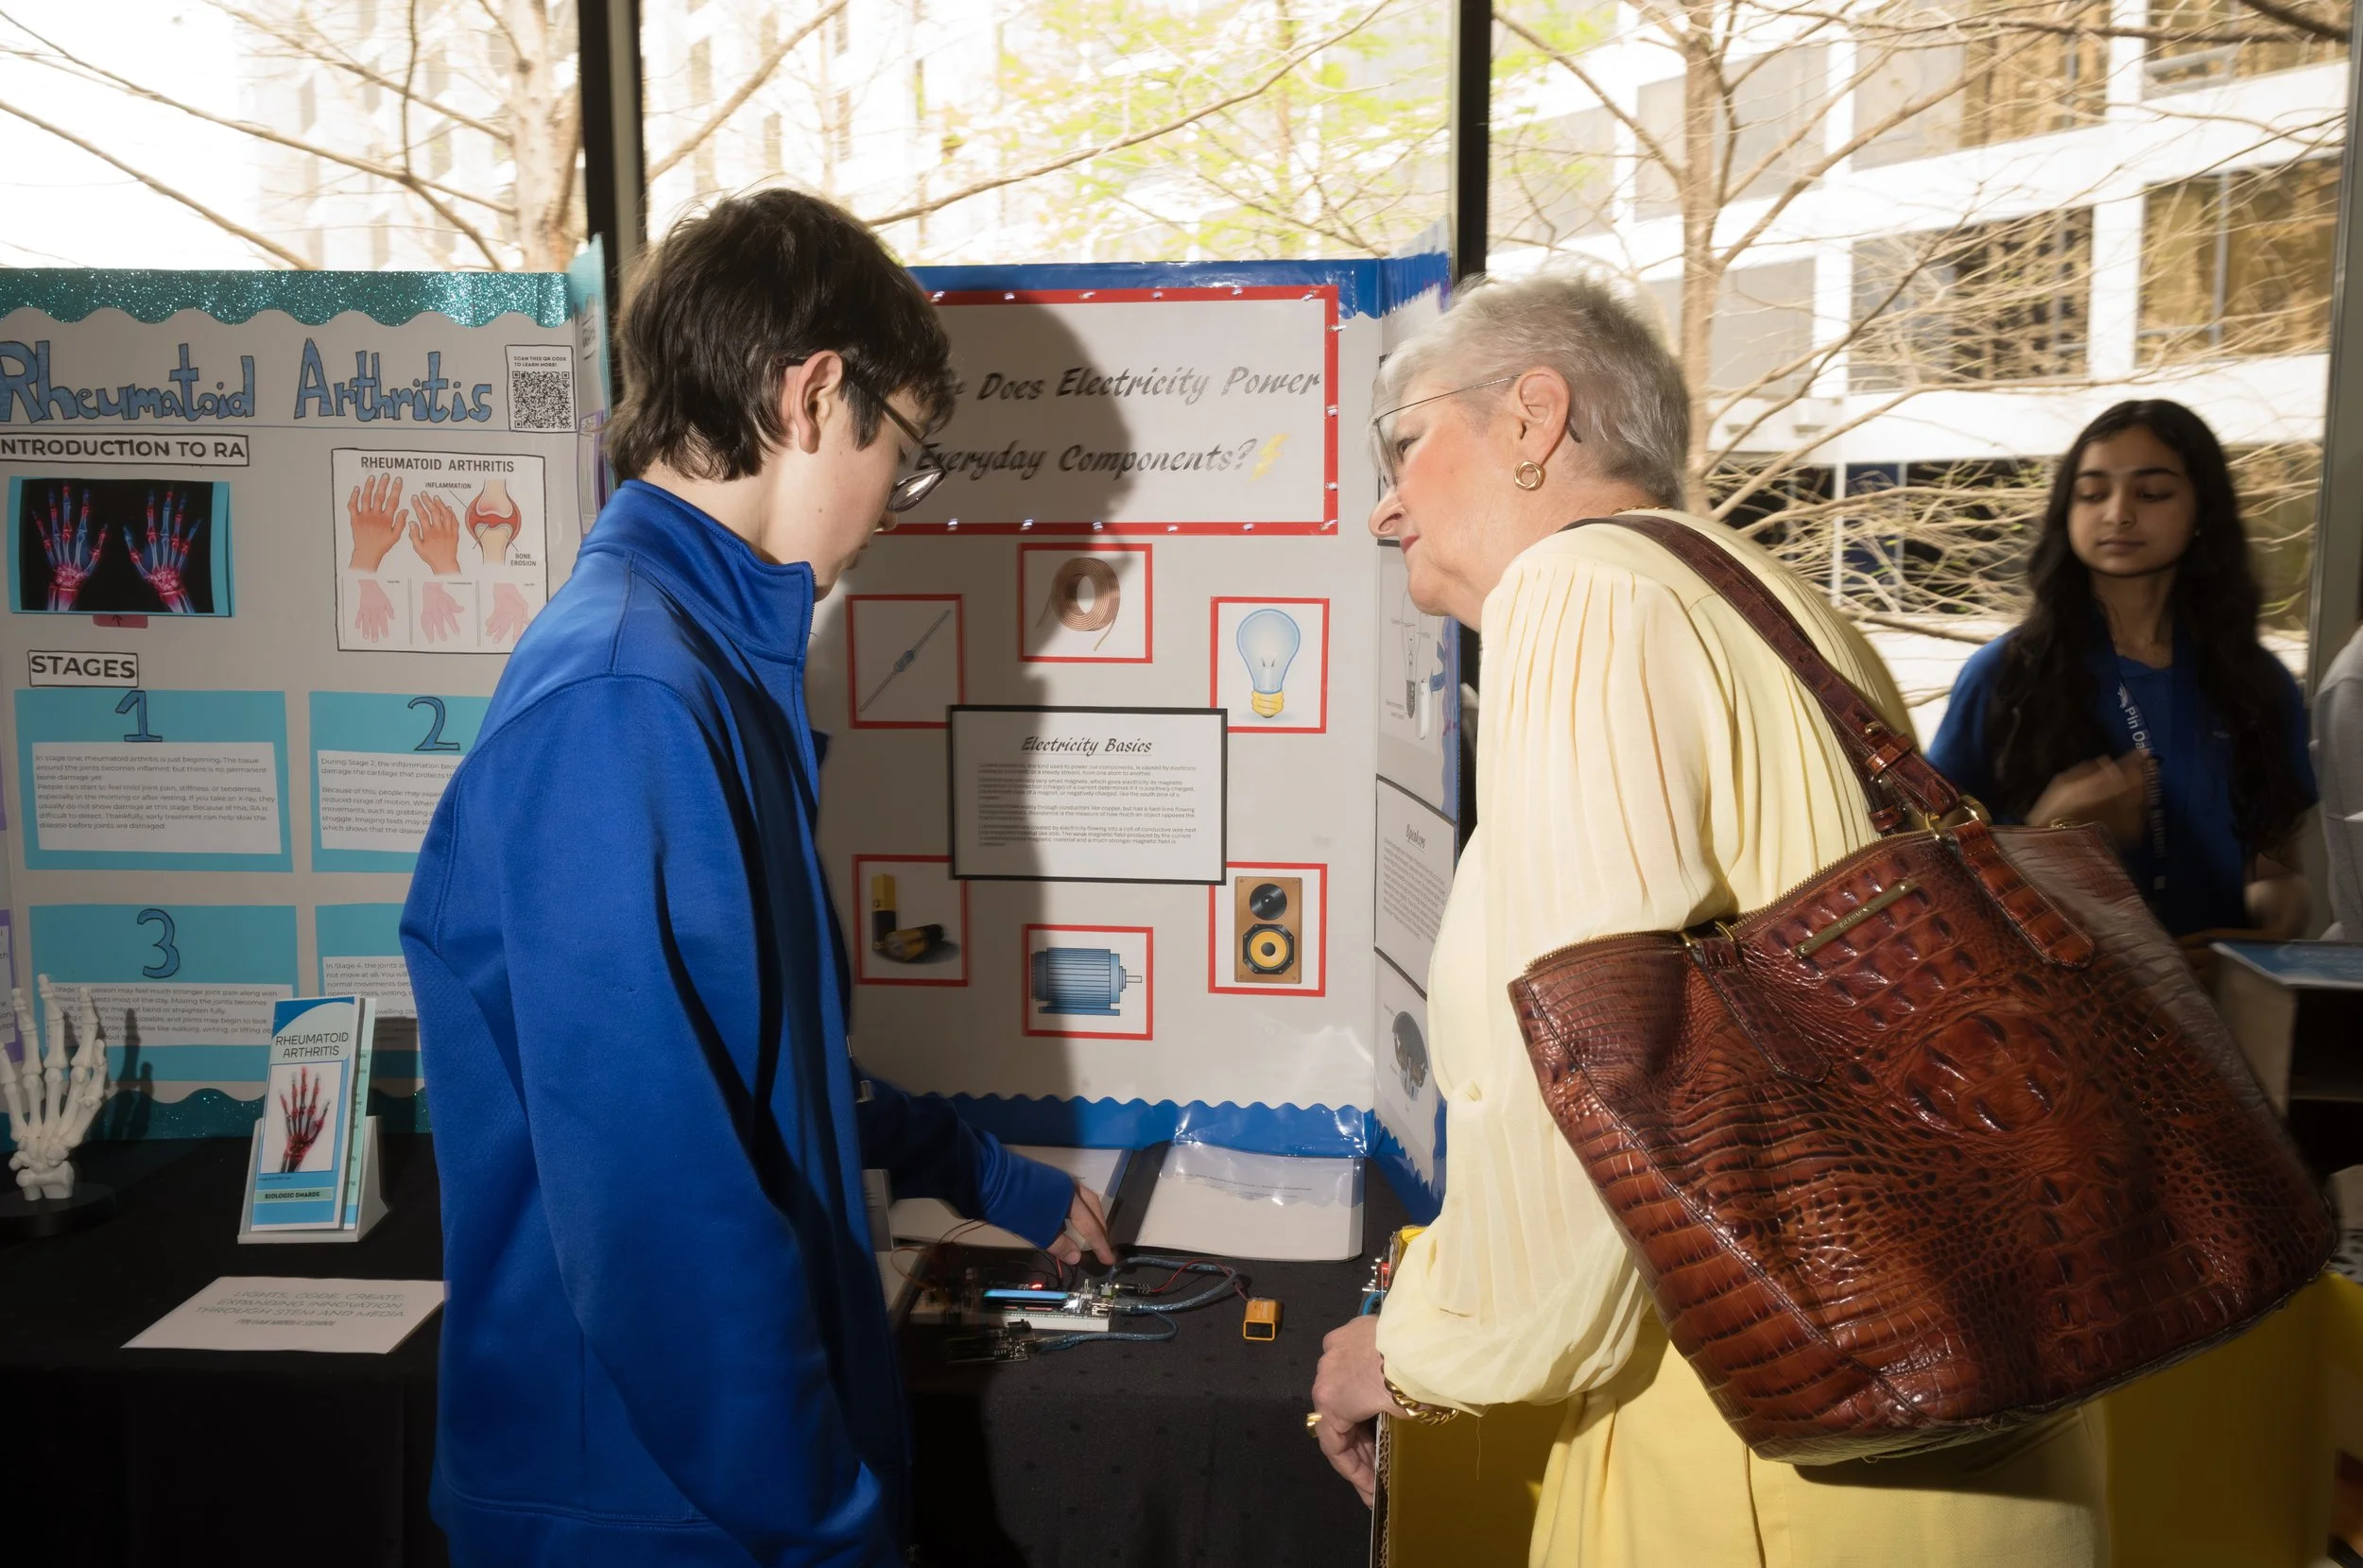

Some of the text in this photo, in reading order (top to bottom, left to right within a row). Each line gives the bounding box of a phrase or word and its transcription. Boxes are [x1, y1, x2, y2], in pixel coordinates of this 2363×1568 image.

[0, 337, 492, 423] Rheumatoid Arthritis
[977, 372, 1045, 401] Does
[1057, 366, 1211, 405] Electricity
[1221, 366, 1321, 397] Power
[0, 439, 246, 458] NTRODUCTION TO RA
[361, 457, 514, 473] RHEUMATOID ARTHRITIS
[915, 438, 1257, 481] Everyday Components?
[30, 655, 135, 680] STAGES
[115, 690, 163, 742] 1
[407, 696, 460, 751] 2
[2125, 706, 2138, 730] Pin
[1021, 736, 1152, 757] Electricity Basics
[321, 759, 346, 767] During
[348, 759, 369, 767] Stage
[58, 774, 89, 783] damage
[321, 768, 352, 777] damage
[367, 769, 397, 778] cartilage
[416, 771, 445, 780] protects
[378, 788, 404, 797] people
[354, 817, 385, 825] Imaging
[397, 809, 427, 818] grabbing
[1406, 823, 1425, 849] Speakers
[137, 908, 181, 979] 3
[275, 1032, 349, 1046] RHEUMATOID
[283, 1045, 339, 1059] ARTHRITIS
[195, 1306, 272, 1316] THROUGH
[273, 1308, 316, 1317] STEM
[216, 1298, 403, 1310] EXPANDING INNOVATION
